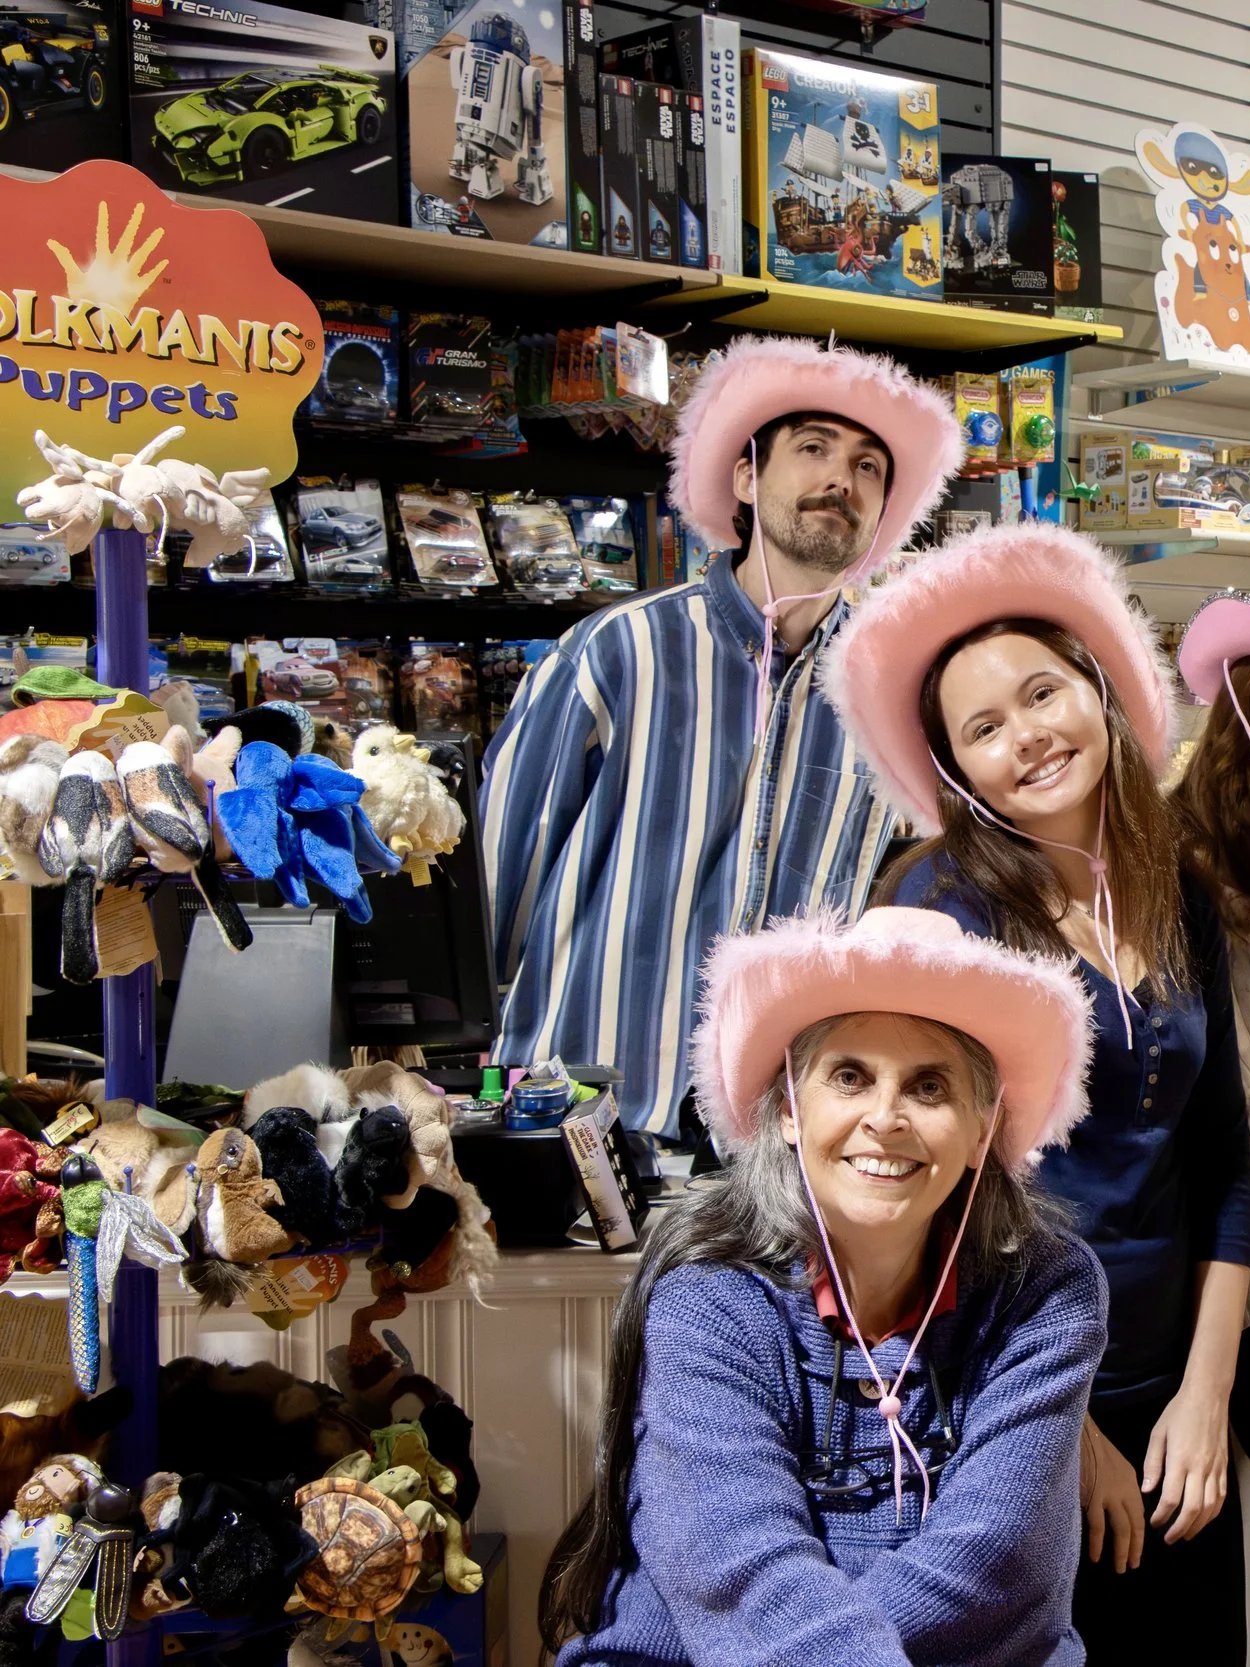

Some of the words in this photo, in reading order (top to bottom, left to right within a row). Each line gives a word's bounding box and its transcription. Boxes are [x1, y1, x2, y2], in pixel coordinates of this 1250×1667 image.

[169, 0, 257, 27] TECHNIC
[132, 19, 151, 31] 9+
[133, 53, 149, 63] 806
[134, 64, 160, 74] pcs/pzs
[763, 67, 787, 82] LEGO
[711, 51, 722, 126] ESPACE
[725, 48, 737, 134] ESPACIO
[794, 71, 857, 96] CREATOR
[771, 96, 788, 109] 9+
[0, 289, 303, 375] OLKMANIS
[444, 350, 478, 360] GRAN
[436, 357, 488, 369] TURISMO
[137, 715, 158, 740] Puppet
[584, 1127, 595, 1142] GLOW
[582, 1138, 593, 1153] DARK
[260, 1285, 279, 1309] Puppet
